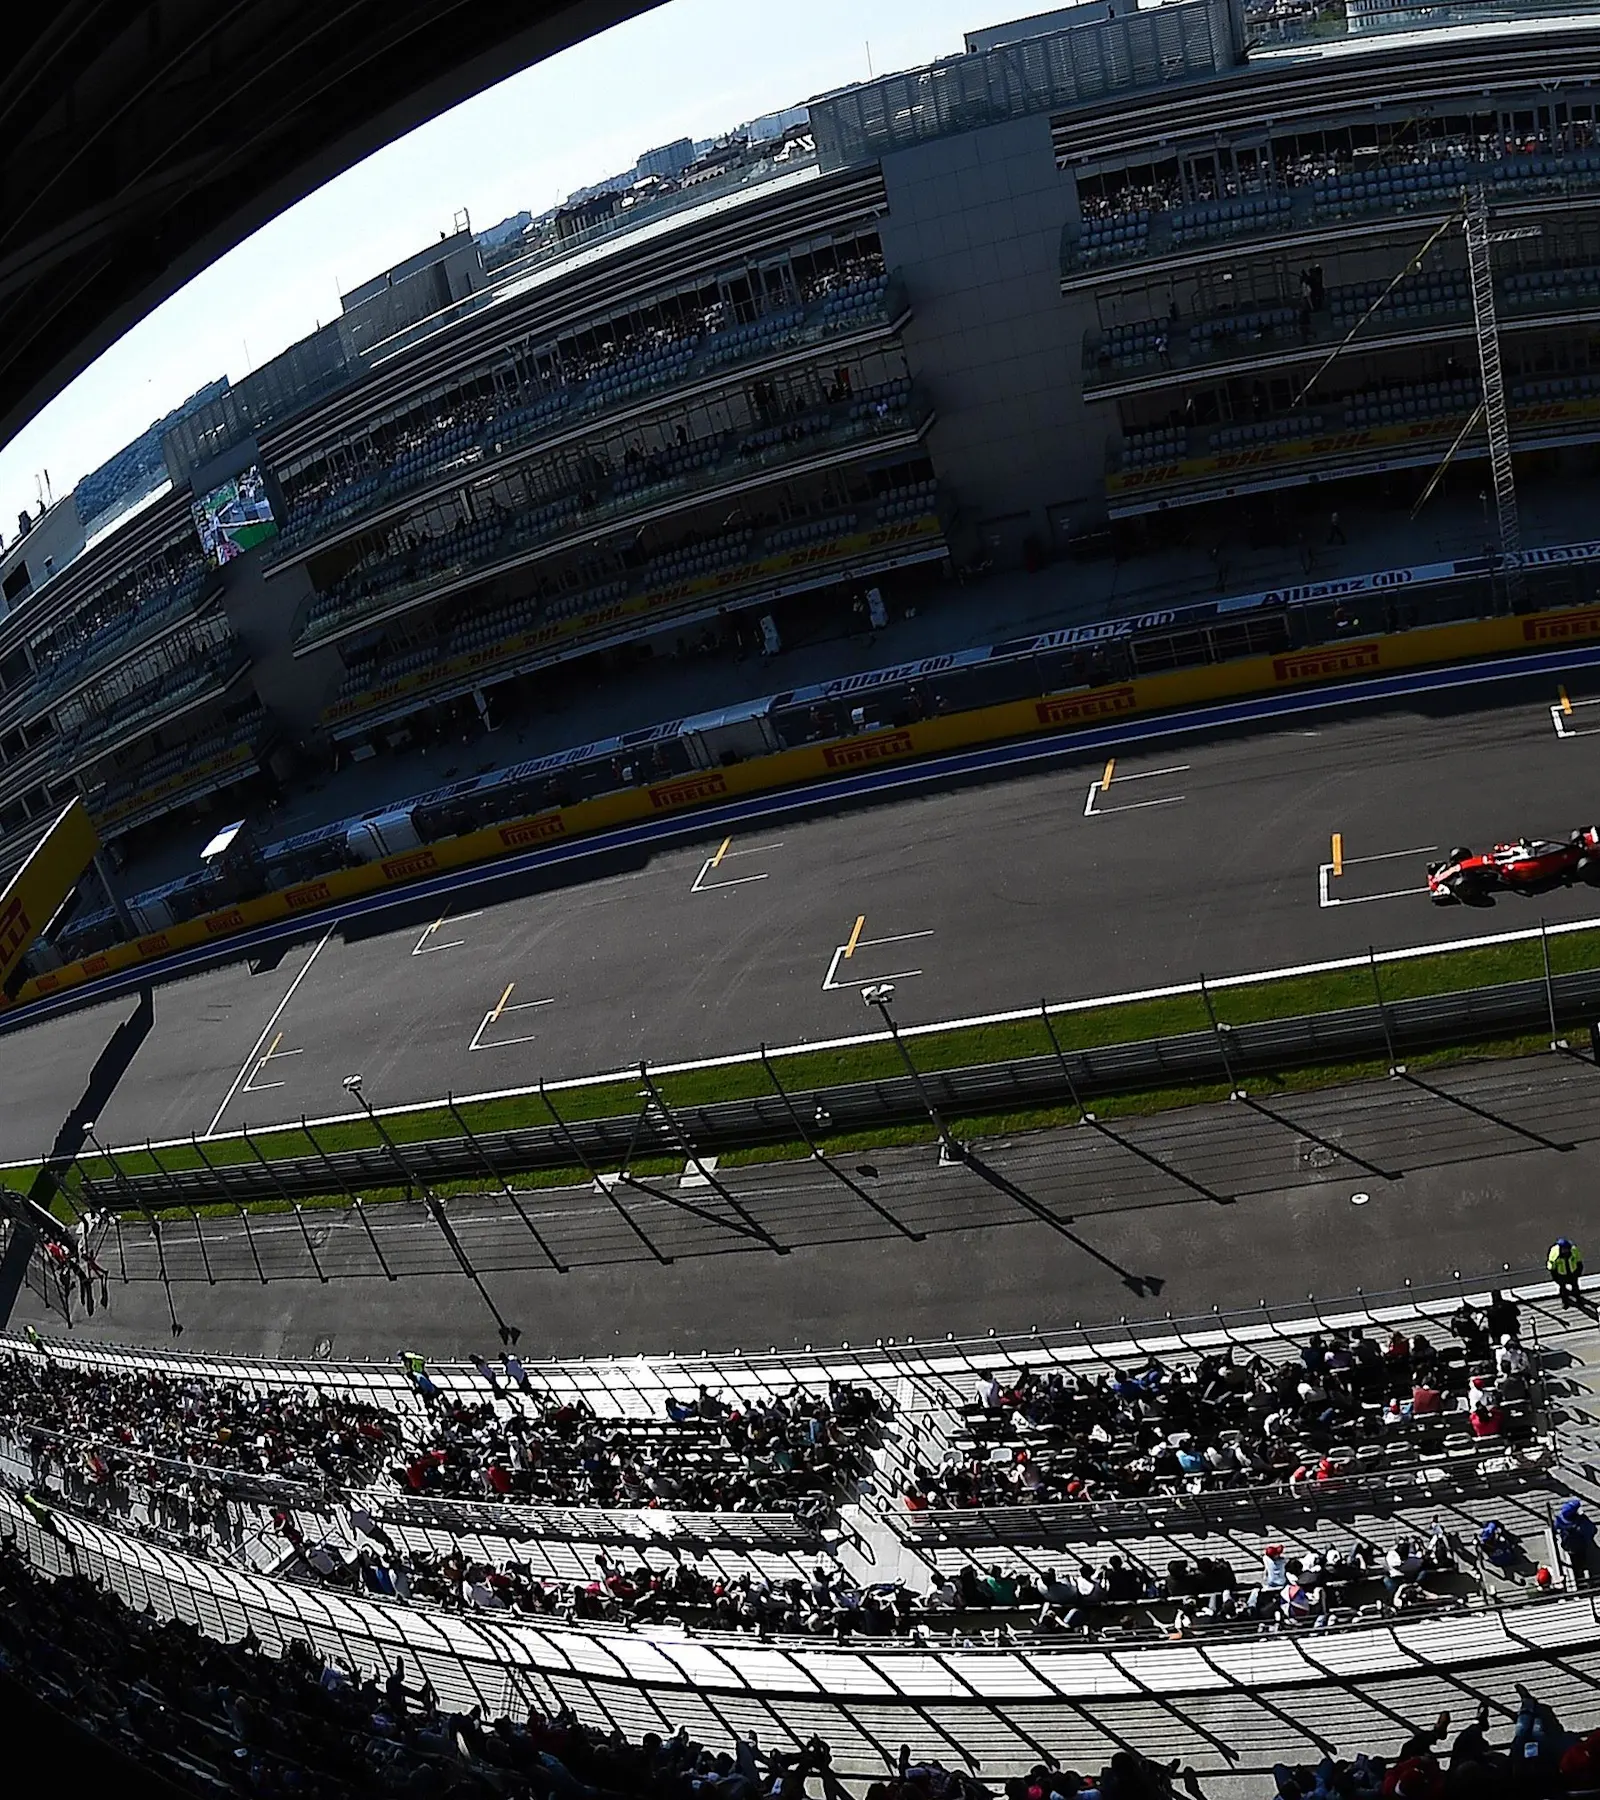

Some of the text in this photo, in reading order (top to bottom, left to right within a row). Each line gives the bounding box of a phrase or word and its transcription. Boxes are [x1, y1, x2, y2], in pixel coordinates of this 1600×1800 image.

[1509, 404, 1567, 421] DHL
[1311, 432, 1374, 452] DHL
[1216, 449, 1280, 468] DHL
[1122, 466, 1184, 487] DHL
[869, 523, 922, 543] DHL
[790, 544, 840, 566] DHL
[716, 565, 763, 586] DHL
[647, 584, 697, 606] DHL
[1261, 579, 1365, 606] Allianz
[1031, 621, 1133, 650] Allianz
[1273, 644, 1380, 680] PIRELLI
[825, 666, 915, 694] Allianz
[1036, 687, 1136, 721] PIRELLI
[822, 731, 914, 767] PIRELLI
[650, 774, 726, 808] PIRELLI
[500, 815, 566, 845] PIRELLI
[382, 852, 438, 878] PIRELLI
